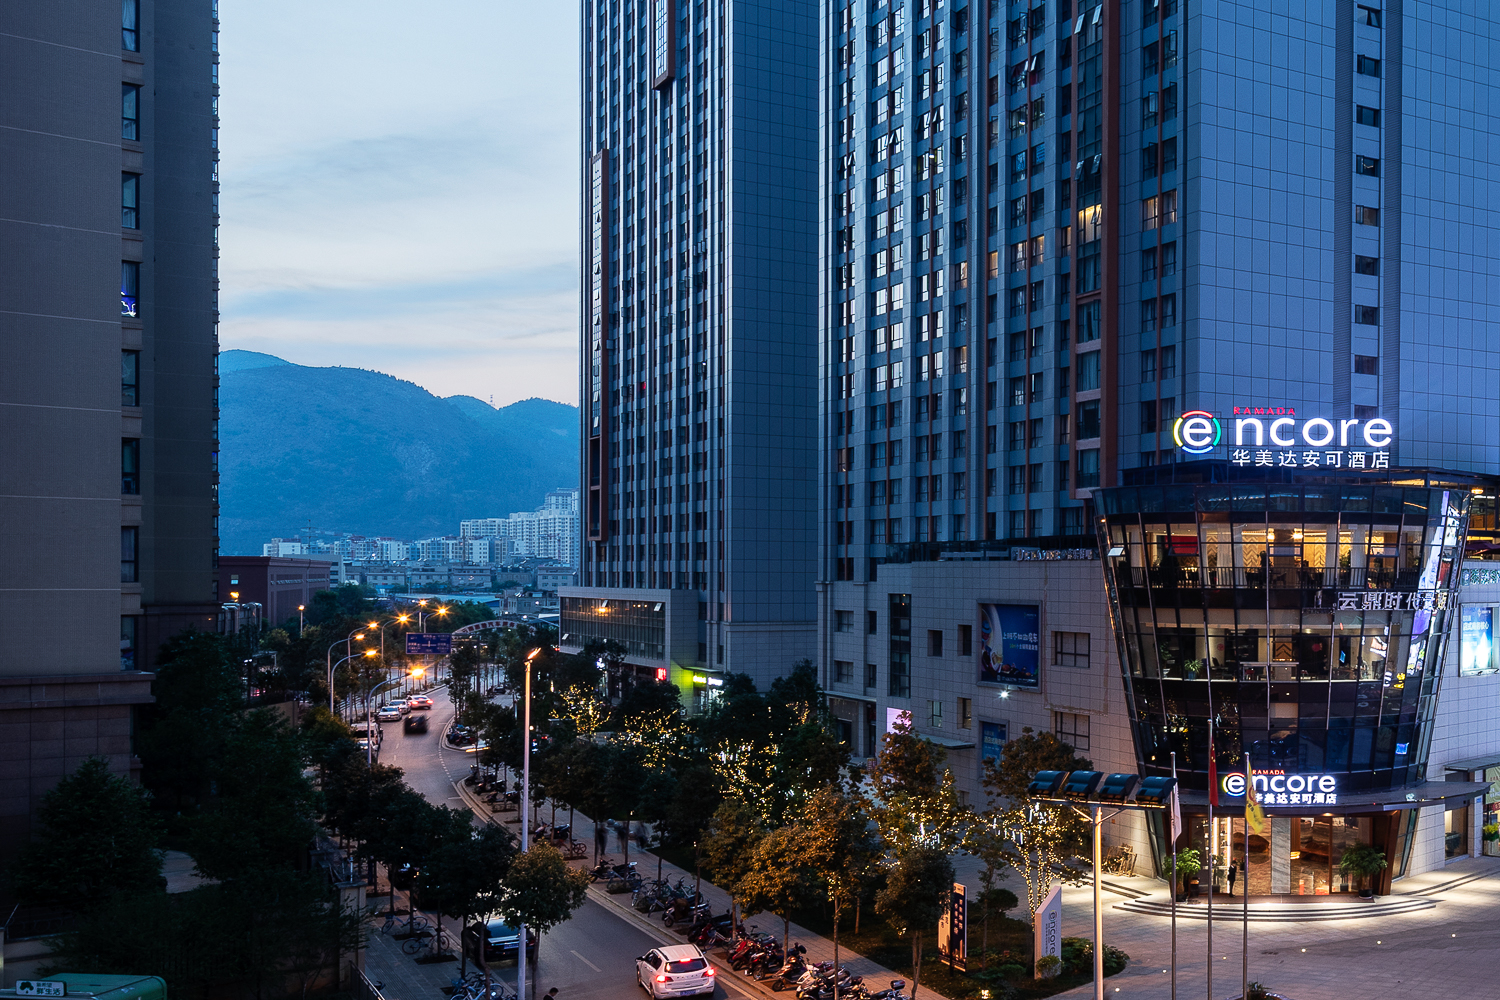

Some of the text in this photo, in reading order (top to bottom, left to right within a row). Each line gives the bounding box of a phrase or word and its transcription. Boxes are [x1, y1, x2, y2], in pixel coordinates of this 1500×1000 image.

[1233, 406, 1296, 416] RAMADA
[1182, 417, 1393, 447] encore
[1232, 449, 1391, 469] 华美达安可酒店
